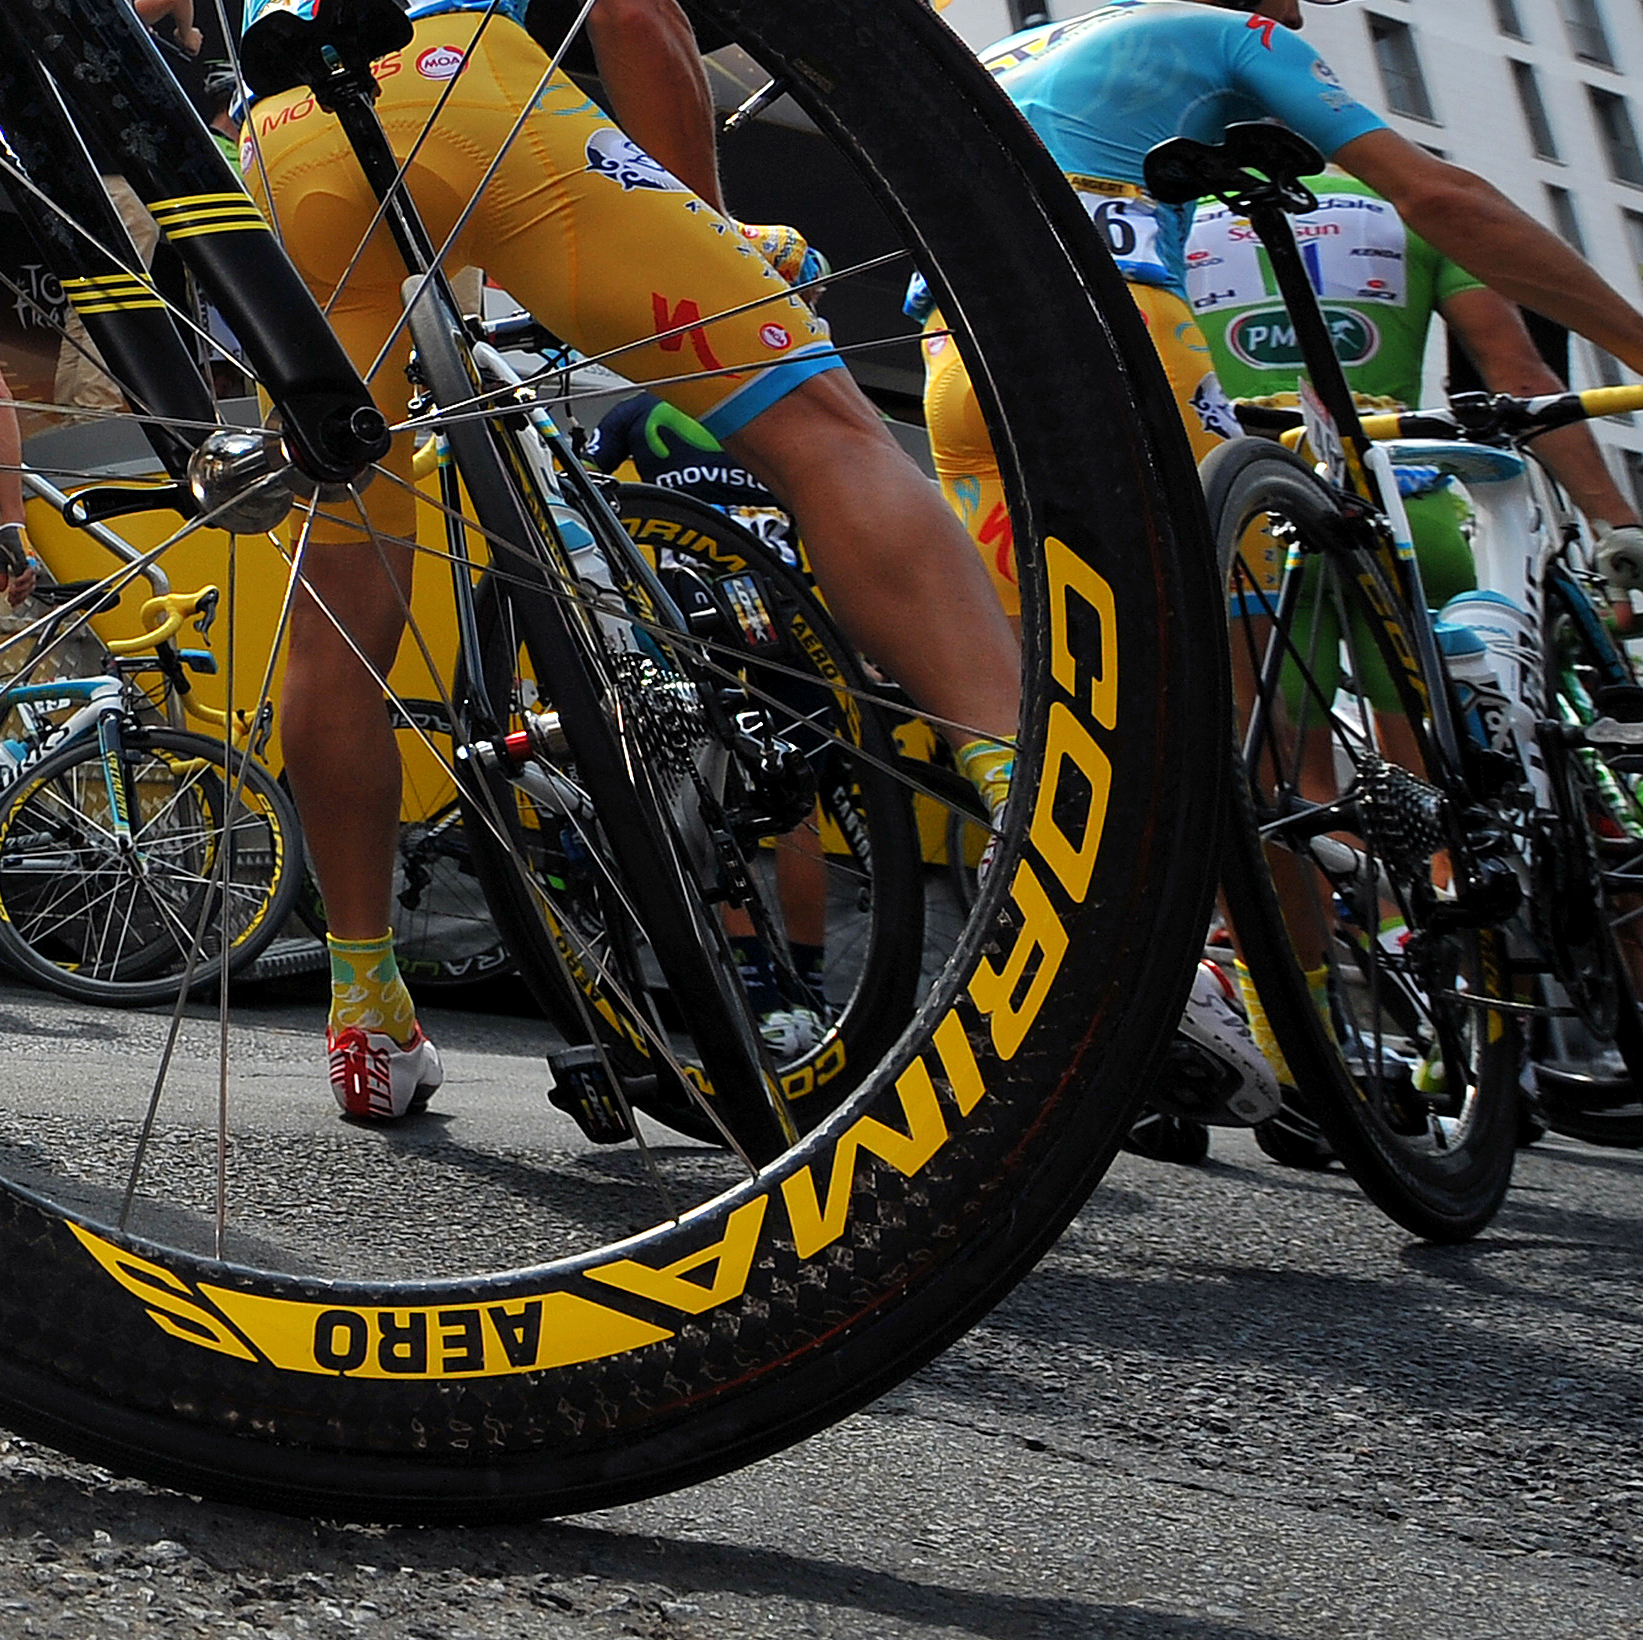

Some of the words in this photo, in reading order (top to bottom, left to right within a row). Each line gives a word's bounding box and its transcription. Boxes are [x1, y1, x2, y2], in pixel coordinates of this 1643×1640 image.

[1245, 322, 1299, 351] PM
[789, 616, 841, 680] AERO
[584, 535, 1119, 1317] CORIMA
[314, 1298, 543, 1376] AERO
